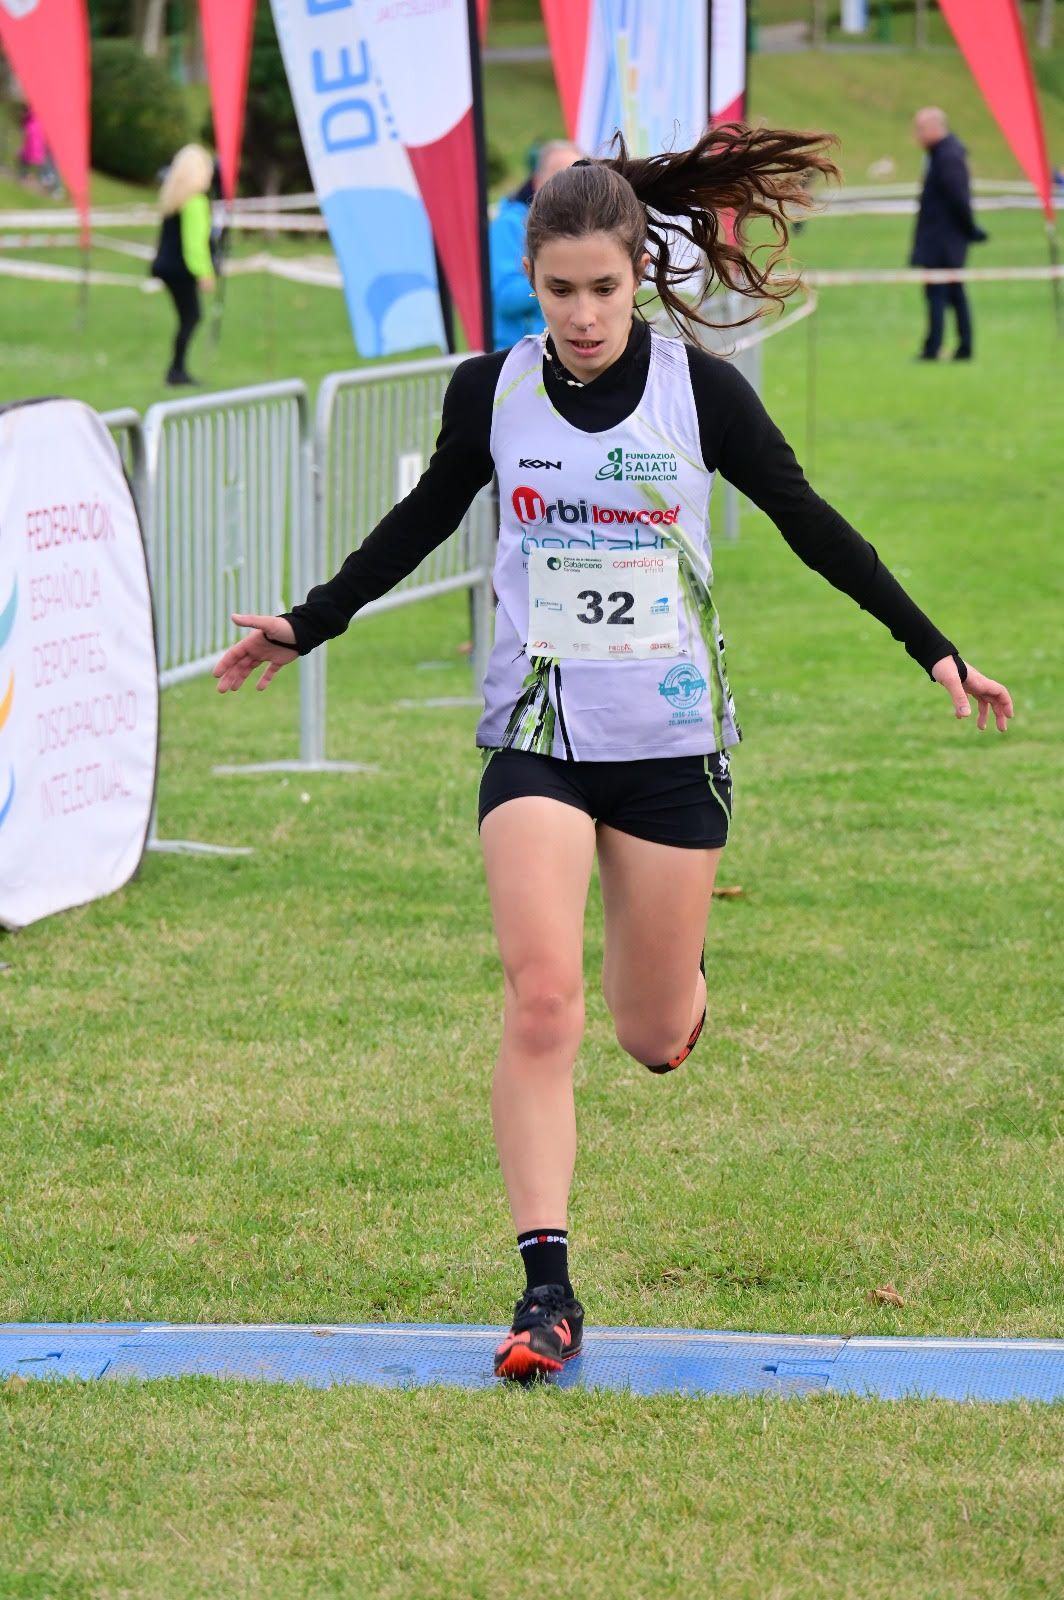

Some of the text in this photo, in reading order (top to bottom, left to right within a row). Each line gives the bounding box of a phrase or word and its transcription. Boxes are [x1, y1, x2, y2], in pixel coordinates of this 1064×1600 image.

[625, 461, 677, 472] SAIATU
[27, 494, 116, 551] FEDERACIÓN
[612, 557, 664, 569] cantabria
[576, 590, 635, 625] 32
[33, 631, 107, 688] DEPORTES
